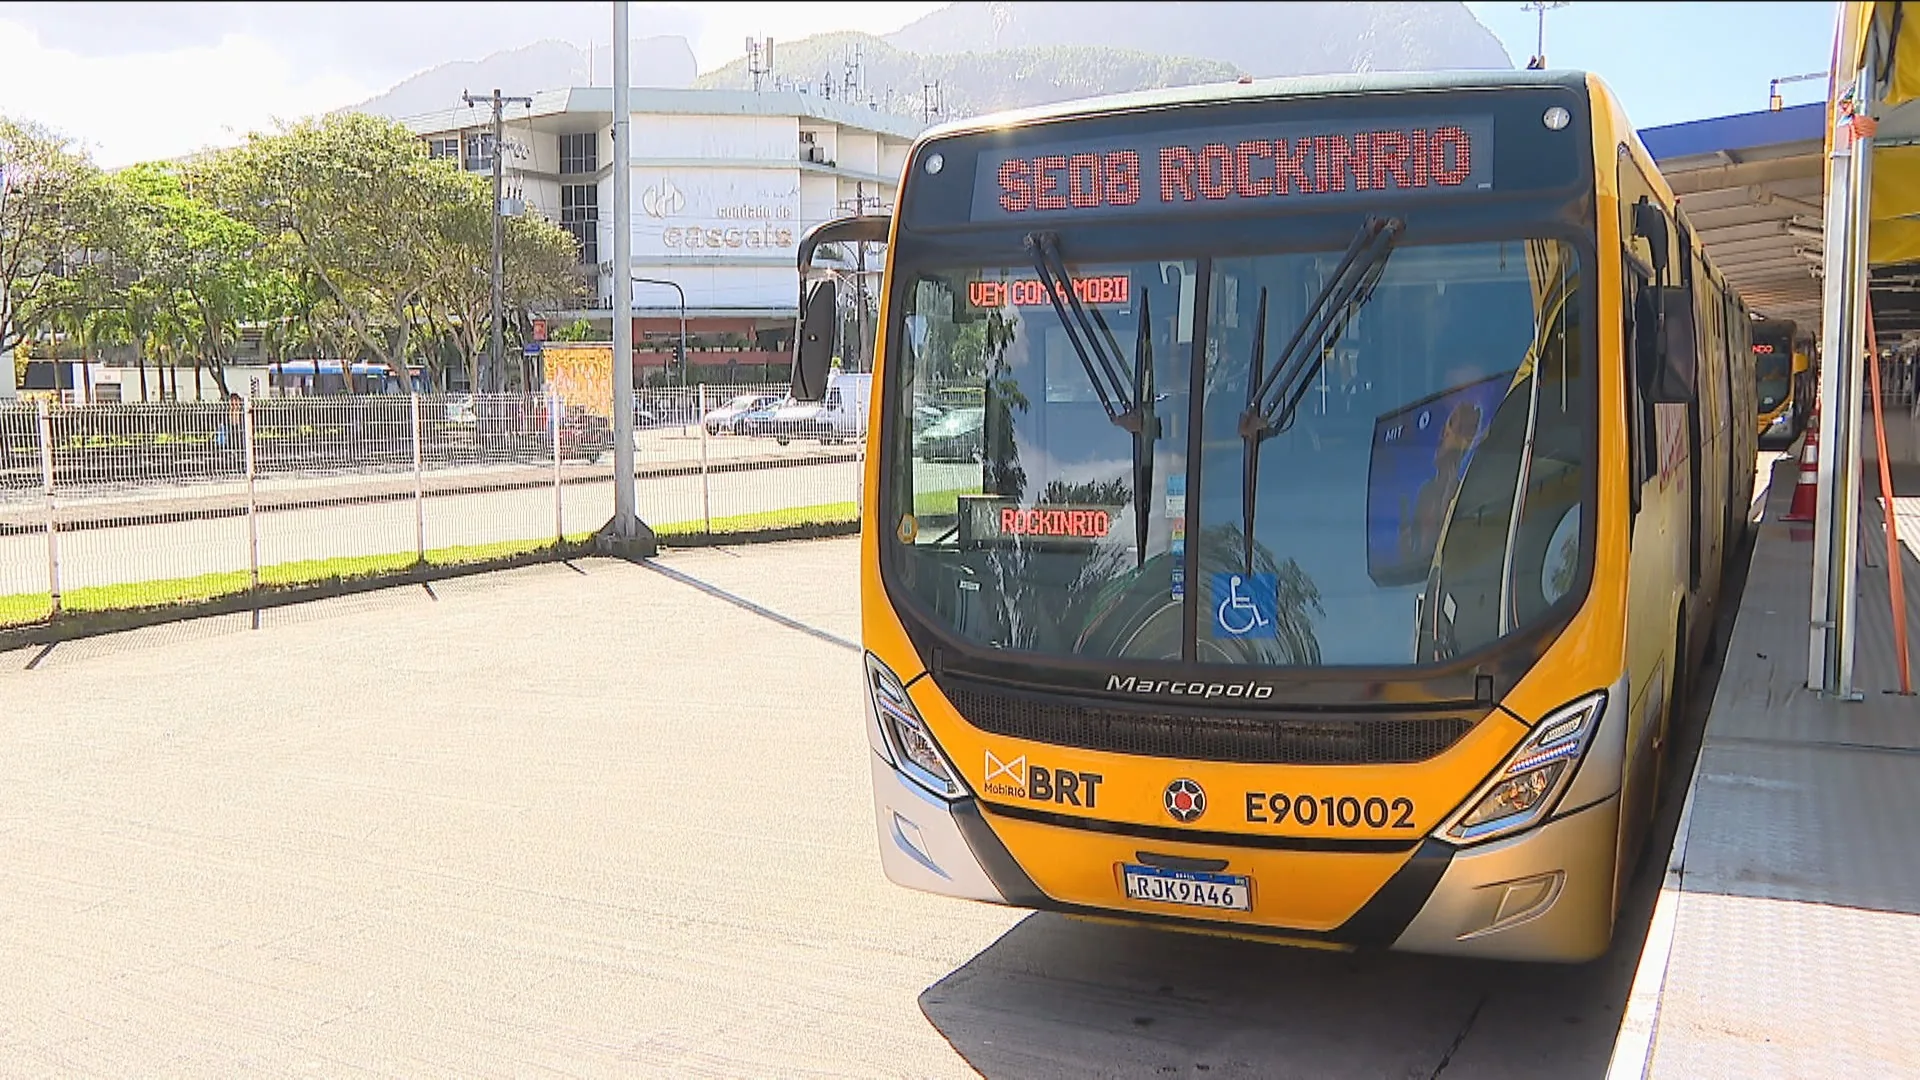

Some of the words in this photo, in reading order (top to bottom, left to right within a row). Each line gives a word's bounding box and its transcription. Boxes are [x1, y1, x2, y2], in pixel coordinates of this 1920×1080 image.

[1158, 125, 1472, 202] ROCKINRIO
[969, 281, 1008, 307] VEM
[1000, 508, 1109, 537] ROCKINRIO
[1105, 674, 1274, 699] Marcopolo
[1029, 765, 1103, 808] BRT
[1246, 792, 1415, 828] E901002
[1136, 877, 1234, 906] RJK9A46
